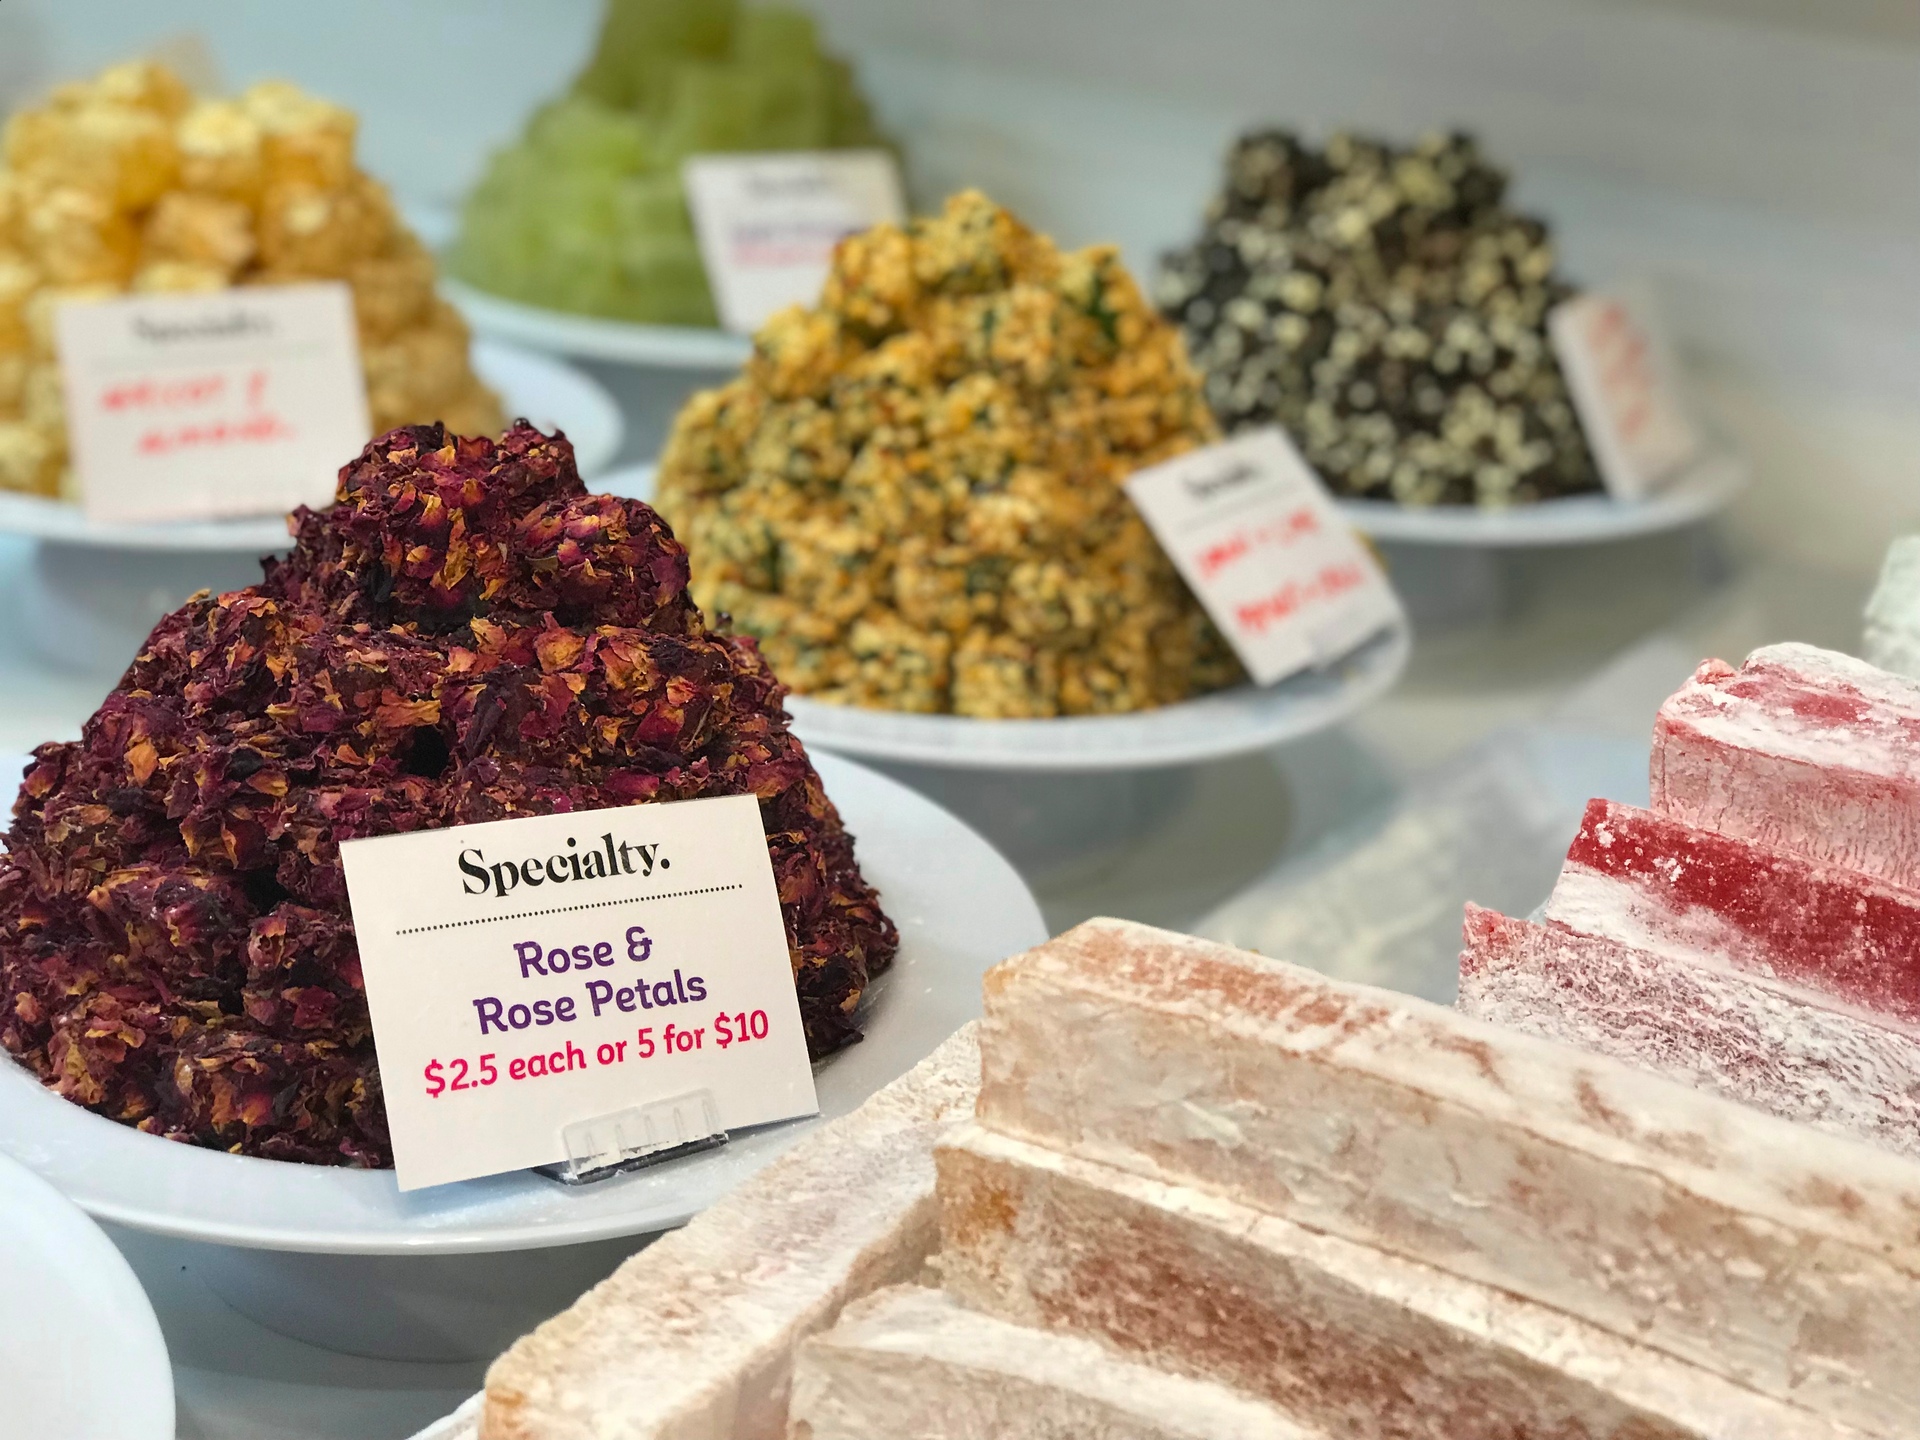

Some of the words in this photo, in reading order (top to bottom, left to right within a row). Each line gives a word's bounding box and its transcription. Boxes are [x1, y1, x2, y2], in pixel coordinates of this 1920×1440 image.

[458, 834, 670, 897] Specialty.
[513, 940, 614, 978] Rose
[626, 926, 653, 962] &
[473, 996, 577, 1034] Rose
[585, 969, 707, 1017] Petals
[424, 1054, 498, 1098] $2.5
[509, 1041, 586, 1081] each
[597, 1039, 628, 1066] or
[638, 1028, 655, 1058] 5
[663, 1024, 705, 1054] for
[714, 1009, 769, 1050] $10
